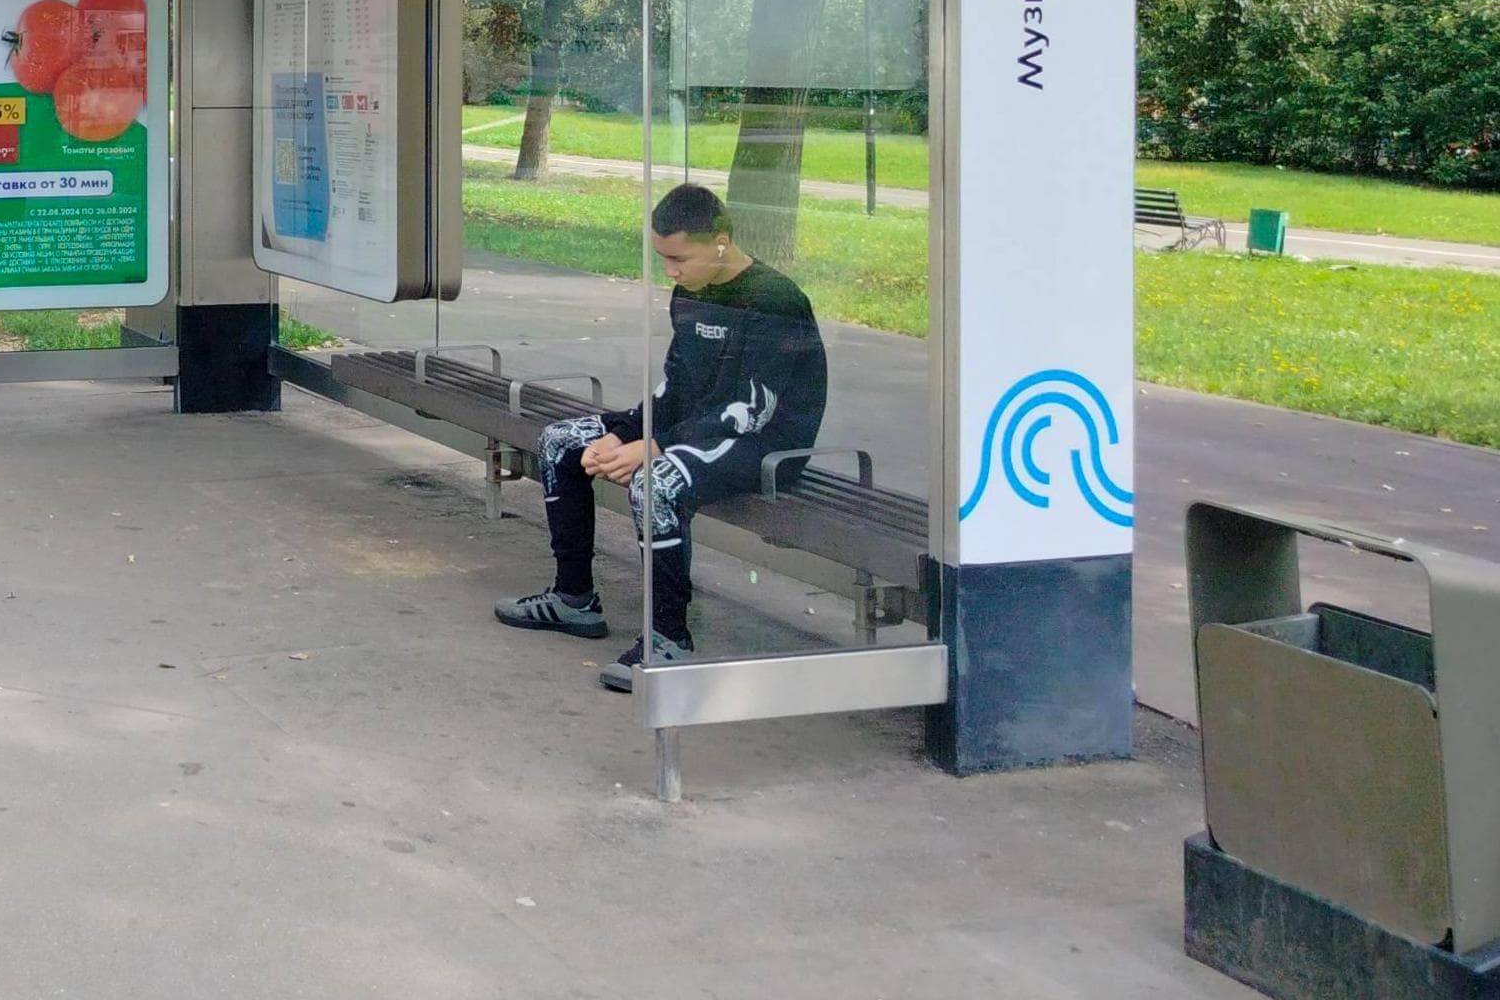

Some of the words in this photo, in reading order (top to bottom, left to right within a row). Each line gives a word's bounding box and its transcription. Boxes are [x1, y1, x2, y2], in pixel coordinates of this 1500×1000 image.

[62, 145, 95, 154] Томаты
[40, 180, 56, 190] от
[59, 177, 77, 188] 30
[81, 179, 109, 189] мин
